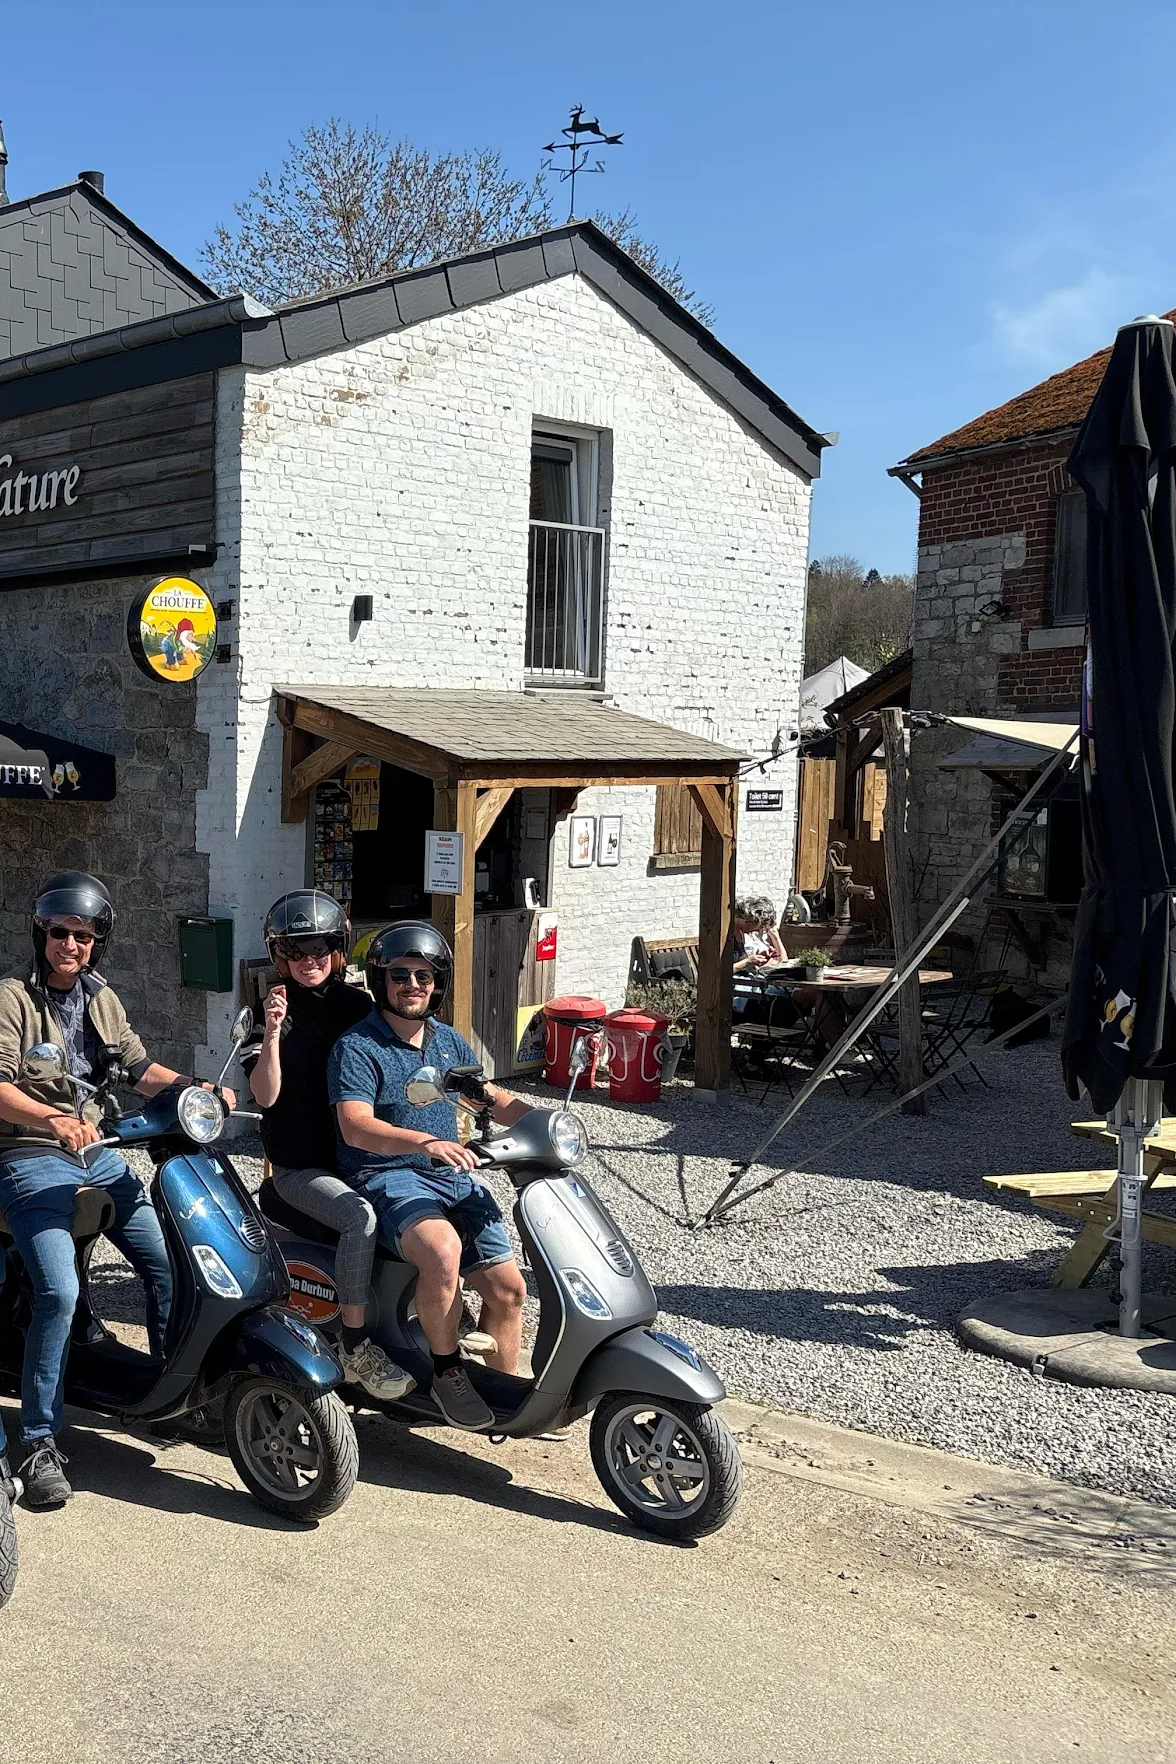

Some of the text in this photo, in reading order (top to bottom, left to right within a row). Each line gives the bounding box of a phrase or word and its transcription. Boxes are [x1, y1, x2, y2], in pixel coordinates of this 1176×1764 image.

[173, 589, 183, 597] LA
[151, 595, 205, 610] CHOUFFE
[301, 1279, 335, 1301] Durbuy
